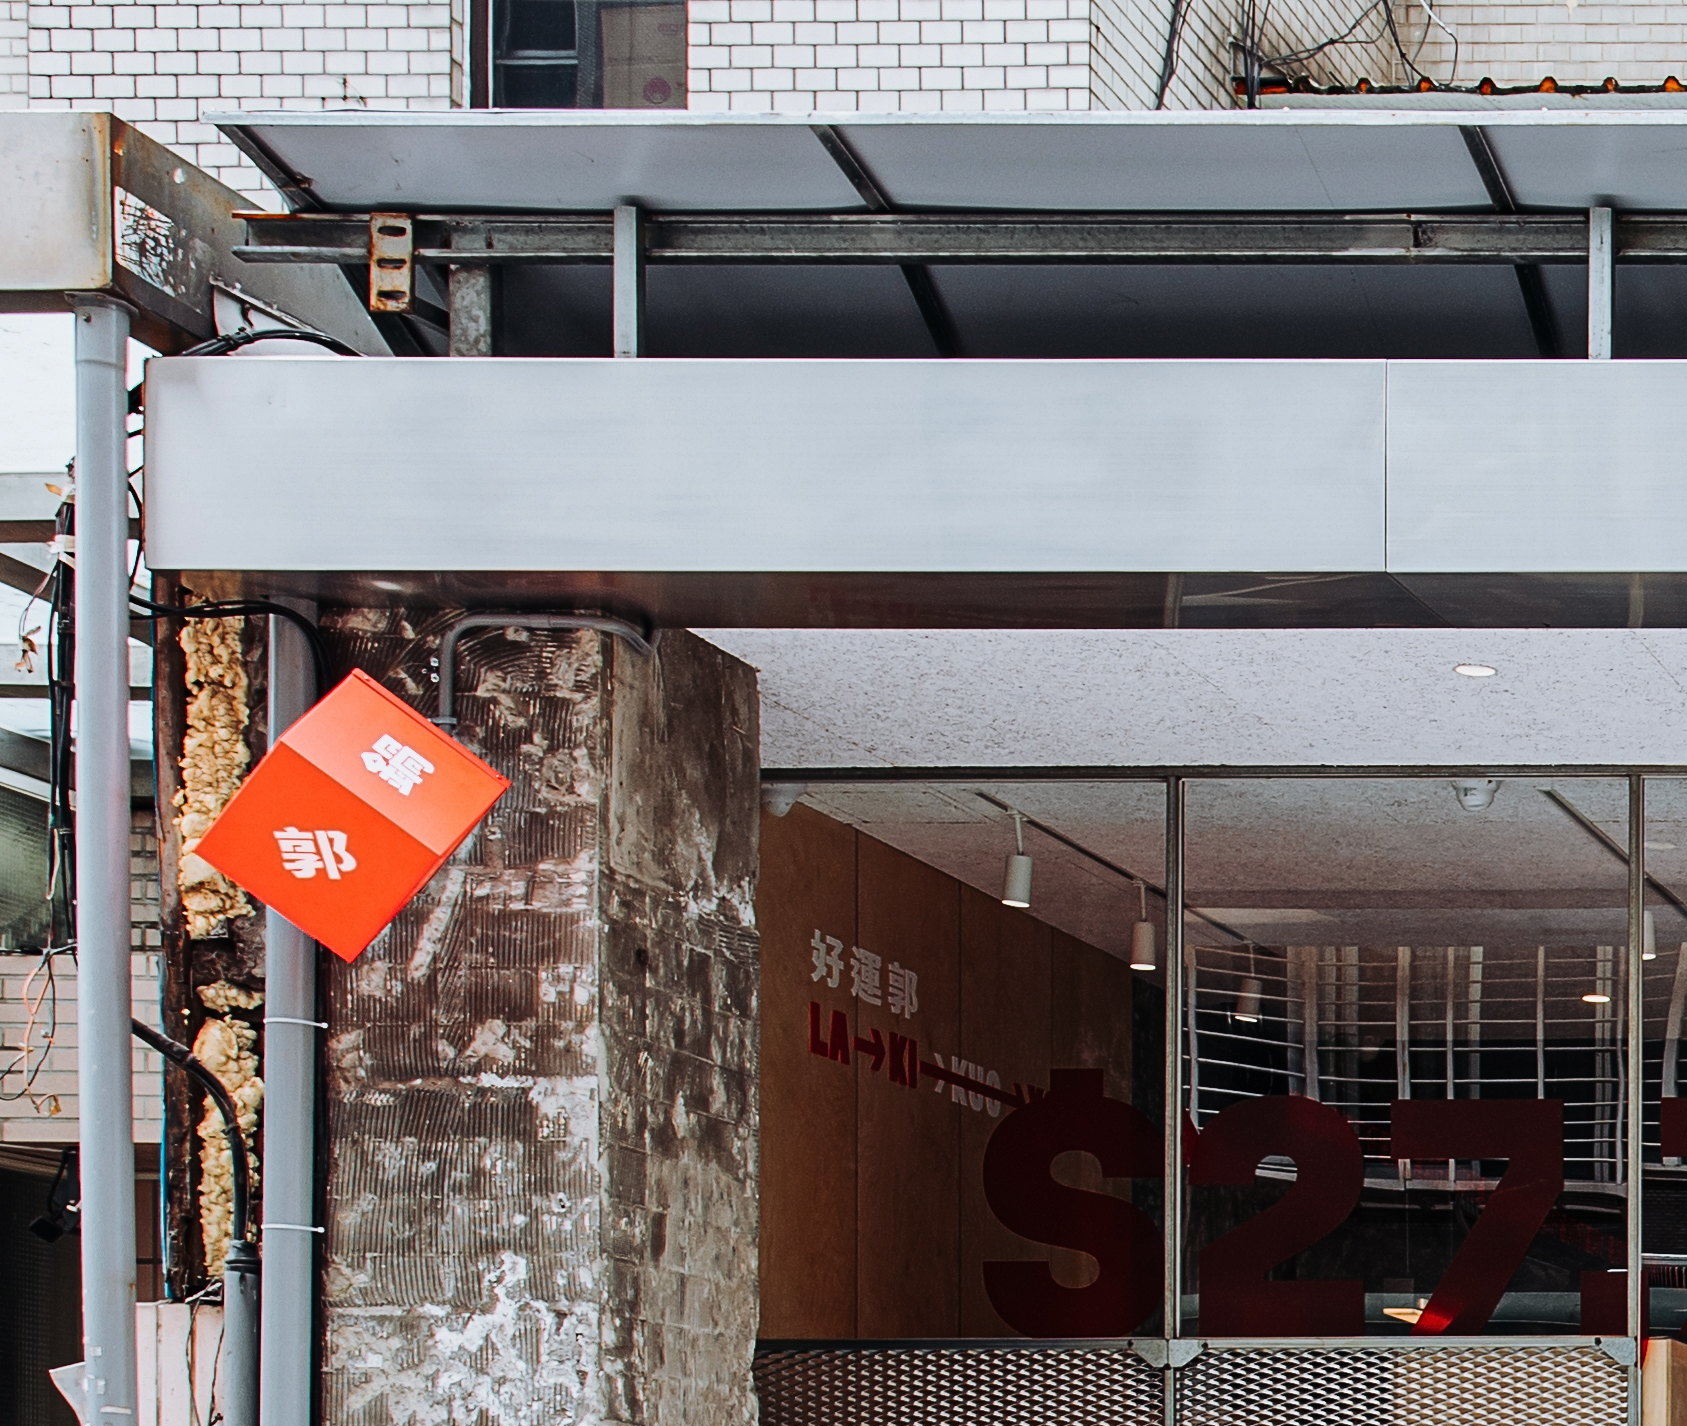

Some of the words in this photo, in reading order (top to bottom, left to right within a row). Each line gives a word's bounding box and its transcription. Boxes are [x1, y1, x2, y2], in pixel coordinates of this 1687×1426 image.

[273, 826, 357, 880] 郭
[810, 929, 919, 1019] 好運郭
[808, 1001, 850, 1065] LA
[888, 1031, 918, 1089] KI
